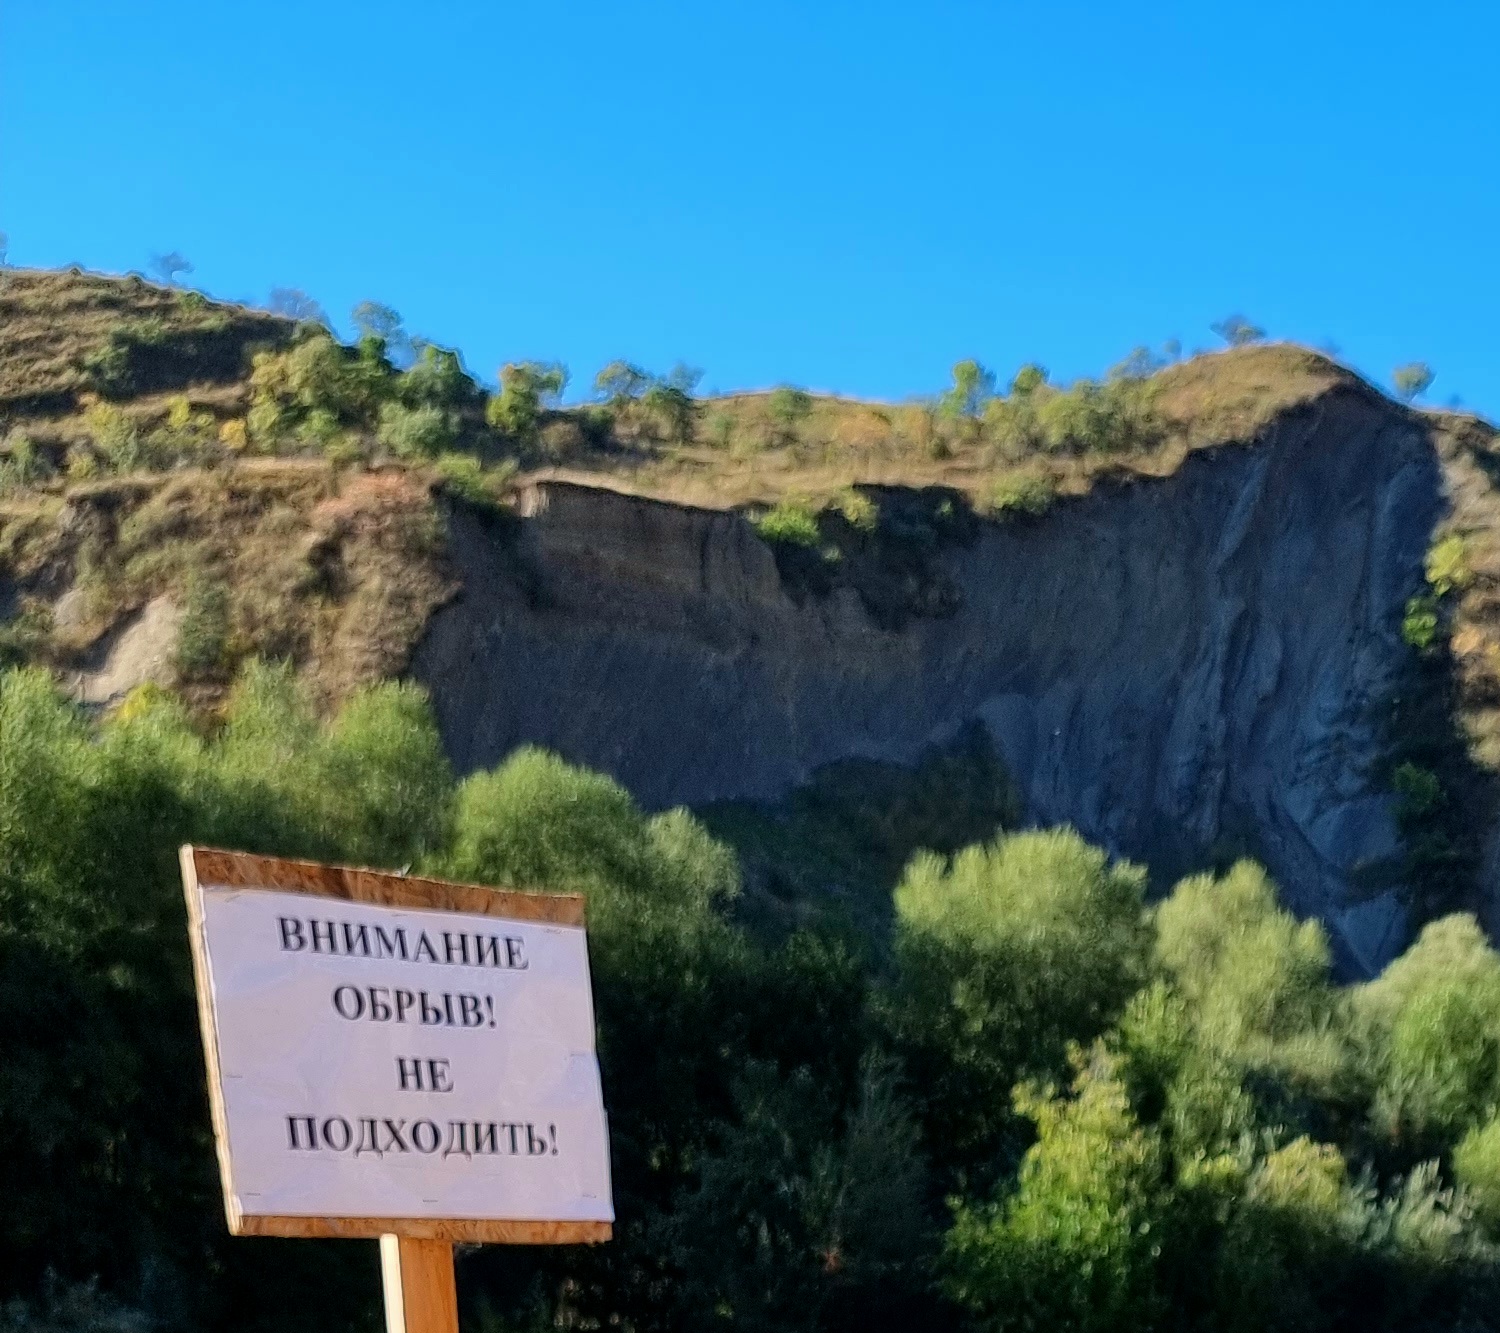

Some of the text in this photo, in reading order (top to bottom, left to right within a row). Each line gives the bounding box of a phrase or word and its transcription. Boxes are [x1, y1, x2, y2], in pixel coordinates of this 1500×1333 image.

[277, 917, 530, 970] ВНИМАНИЕ
[332, 985, 498, 1028] ОБРЫВ!
[396, 1056, 454, 1093] НЕ
[285, 1115, 559, 1160] ПОДХОДИТЬ!
